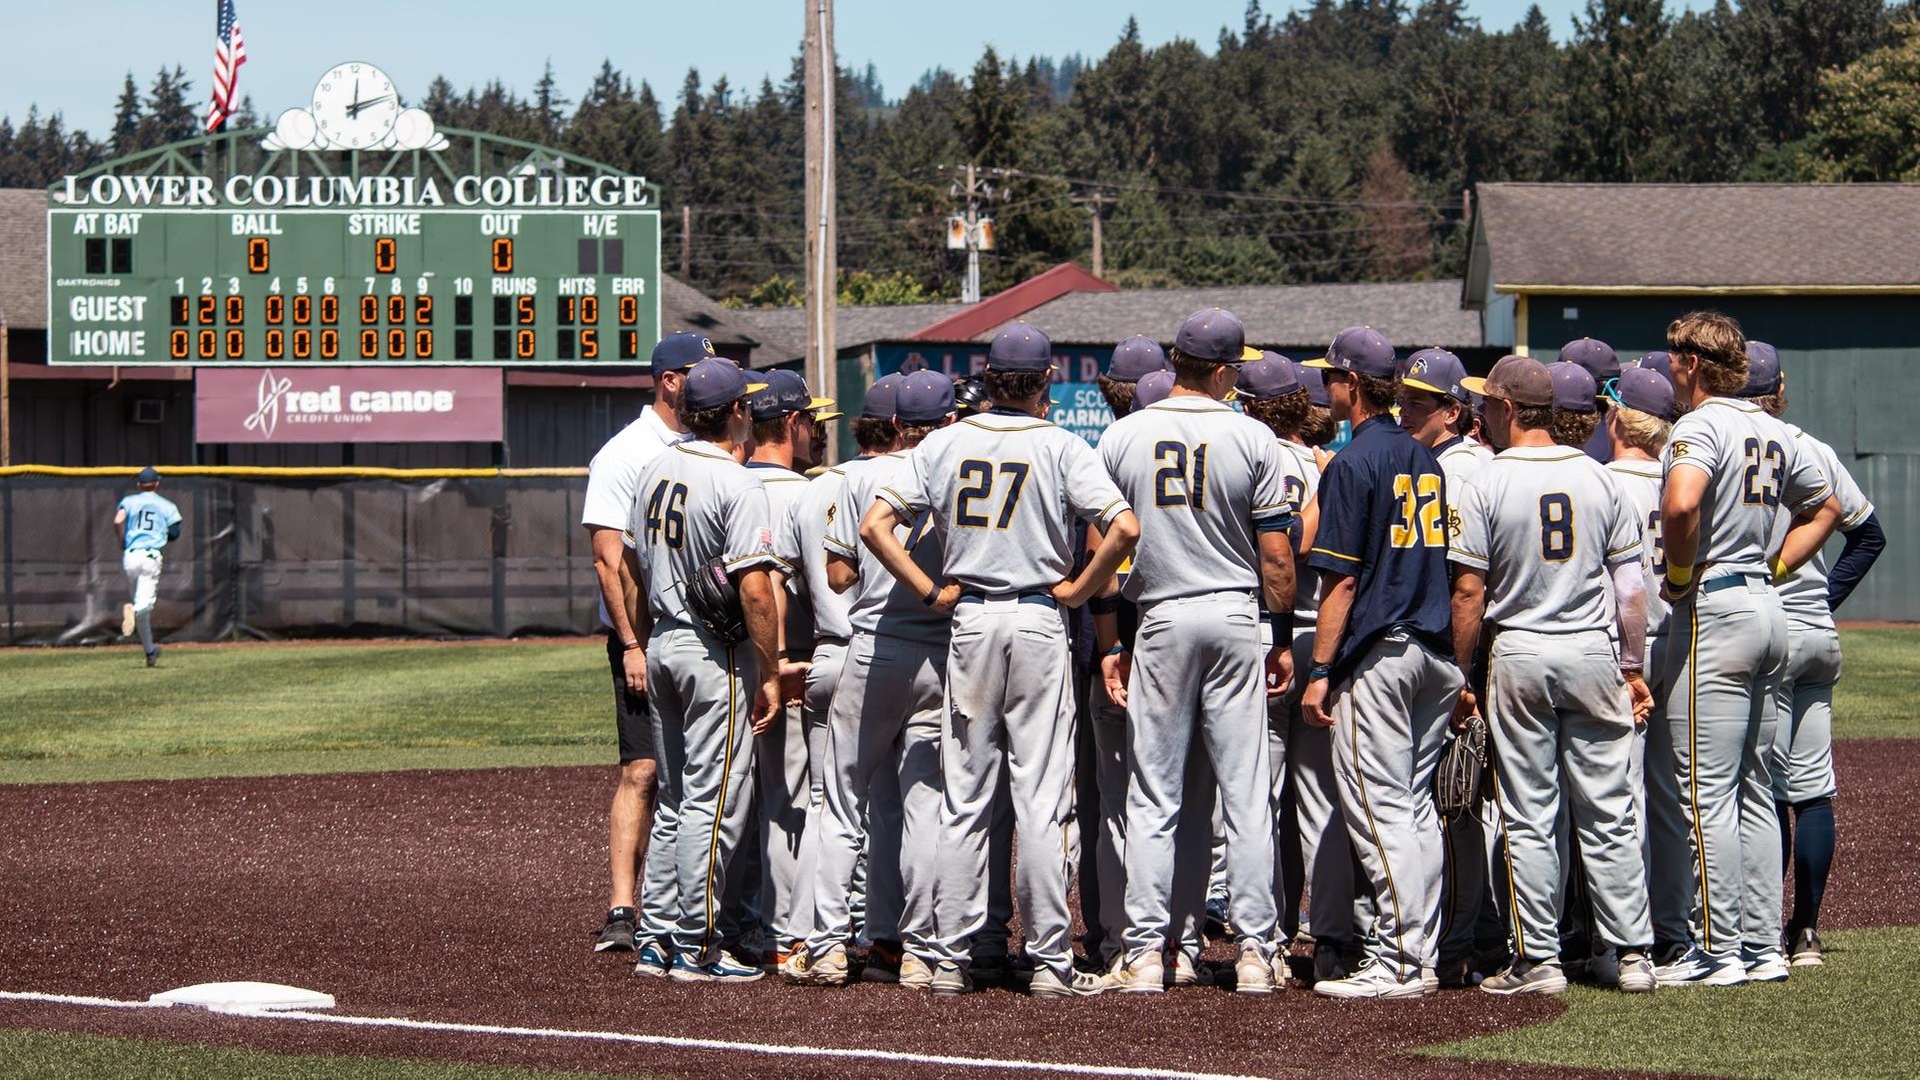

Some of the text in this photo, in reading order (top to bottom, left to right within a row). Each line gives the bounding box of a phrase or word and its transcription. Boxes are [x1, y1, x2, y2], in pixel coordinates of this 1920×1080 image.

[333, 70, 342, 79] 11
[351, 65, 360, 74] 12
[371, 70, 376, 78] 1
[321, 84, 331, 92] 10
[384, 83, 390, 91] 2
[315, 102, 321, 110] 9
[389, 102, 395, 110] 3
[321, 120, 327, 129] 8
[384, 120, 389, 128] 4
[335, 133, 341, 141] 7
[352, 137, 358, 146] 6
[370, 133, 377, 141] 5
[63, 175, 647, 206] LOWER COLUMBIA COLLEGE
[74, 214, 142, 235] AT BAT
[232, 214, 283, 235] BALL
[348, 215, 421, 235] STRIKE
[481, 215, 522, 235] OUT
[583, 215, 618, 236] H/E
[249, 238, 268, 272] 0
[376, 238, 395, 272] 0
[493, 238, 512, 272] 0
[175, 277, 645, 295] 1 2 3 4 5 6 7 8 9 10 RUNS HITS ERR
[70, 296, 147, 321] GUEST
[199, 296, 215, 323] 2
[227, 296, 243, 323] 0
[267, 296, 283, 323] 0
[294, 296, 310, 323] 0
[321, 296, 338, 323] 0
[361, 296, 378, 323] 0
[388, 296, 405, 323] 0
[416, 296, 432, 323] 2
[518, 297, 534, 323] 5
[568, 297, 598, 323] 10
[620, 297, 637, 323] 0
[72, 330, 145, 356] HOME
[171, 330, 188, 357] 0
[199, 330, 215, 357] 0
[227, 330, 243, 357] 0
[267, 330, 283, 357] 0
[294, 330, 310, 357] 0
[321, 330, 338, 357] 0
[361, 330, 378, 357] 0
[388, 330, 405, 357] 0
[416, 330, 432, 357] 0
[518, 330, 534, 357] 0
[581, 330, 597, 357] 5
[286, 385, 453, 413] red canoe
[287, 414, 372, 423] CREDIT UNION
[1053, 408, 1116, 426] CARNA
[1154, 440, 1208, 511] 21
[1743, 437, 1786, 506] 23
[955, 459, 1030, 530] 27
[137, 510, 156, 531] 15
[646, 479, 688, 550] 46
[1390, 473, 1446, 549] 32
[1539, 492, 1575, 562] 8
